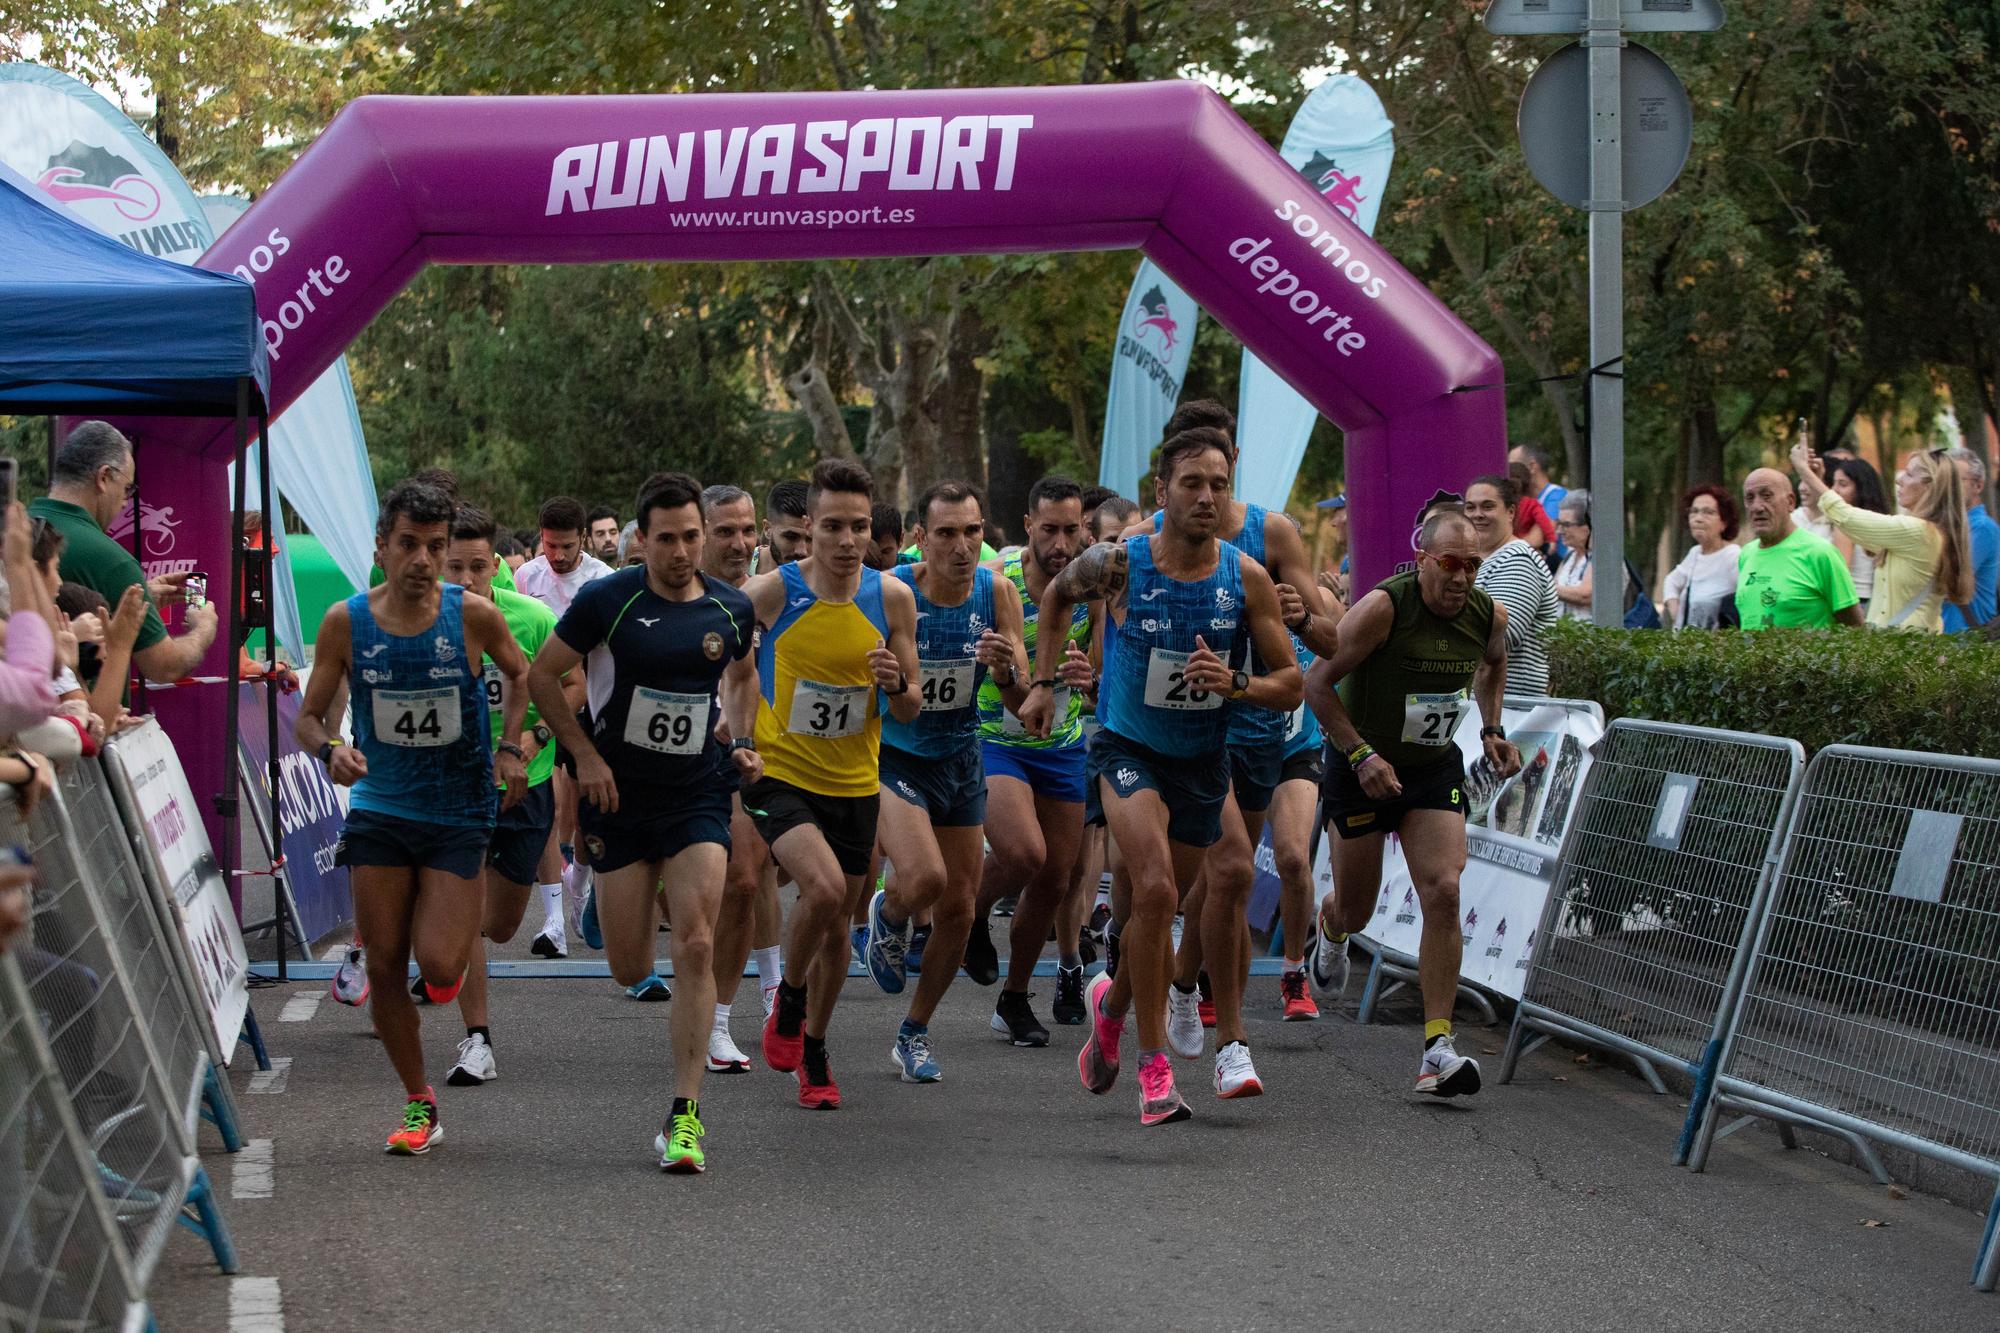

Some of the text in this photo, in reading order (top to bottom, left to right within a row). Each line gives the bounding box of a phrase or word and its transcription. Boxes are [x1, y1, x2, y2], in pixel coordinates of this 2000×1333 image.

[545, 115, 1034, 216] RUNVASPORT
[670, 206, 915, 229] www.runvasport.es
[1274, 199, 1388, 298] somos
[1228, 237, 1367, 357] deporte
[921, 677, 957, 704] 46
[394, 708, 442, 739] 44
[647, 712, 693, 747] 69
[809, 701, 849, 731] 31
[1420, 710, 1460, 739] 27
